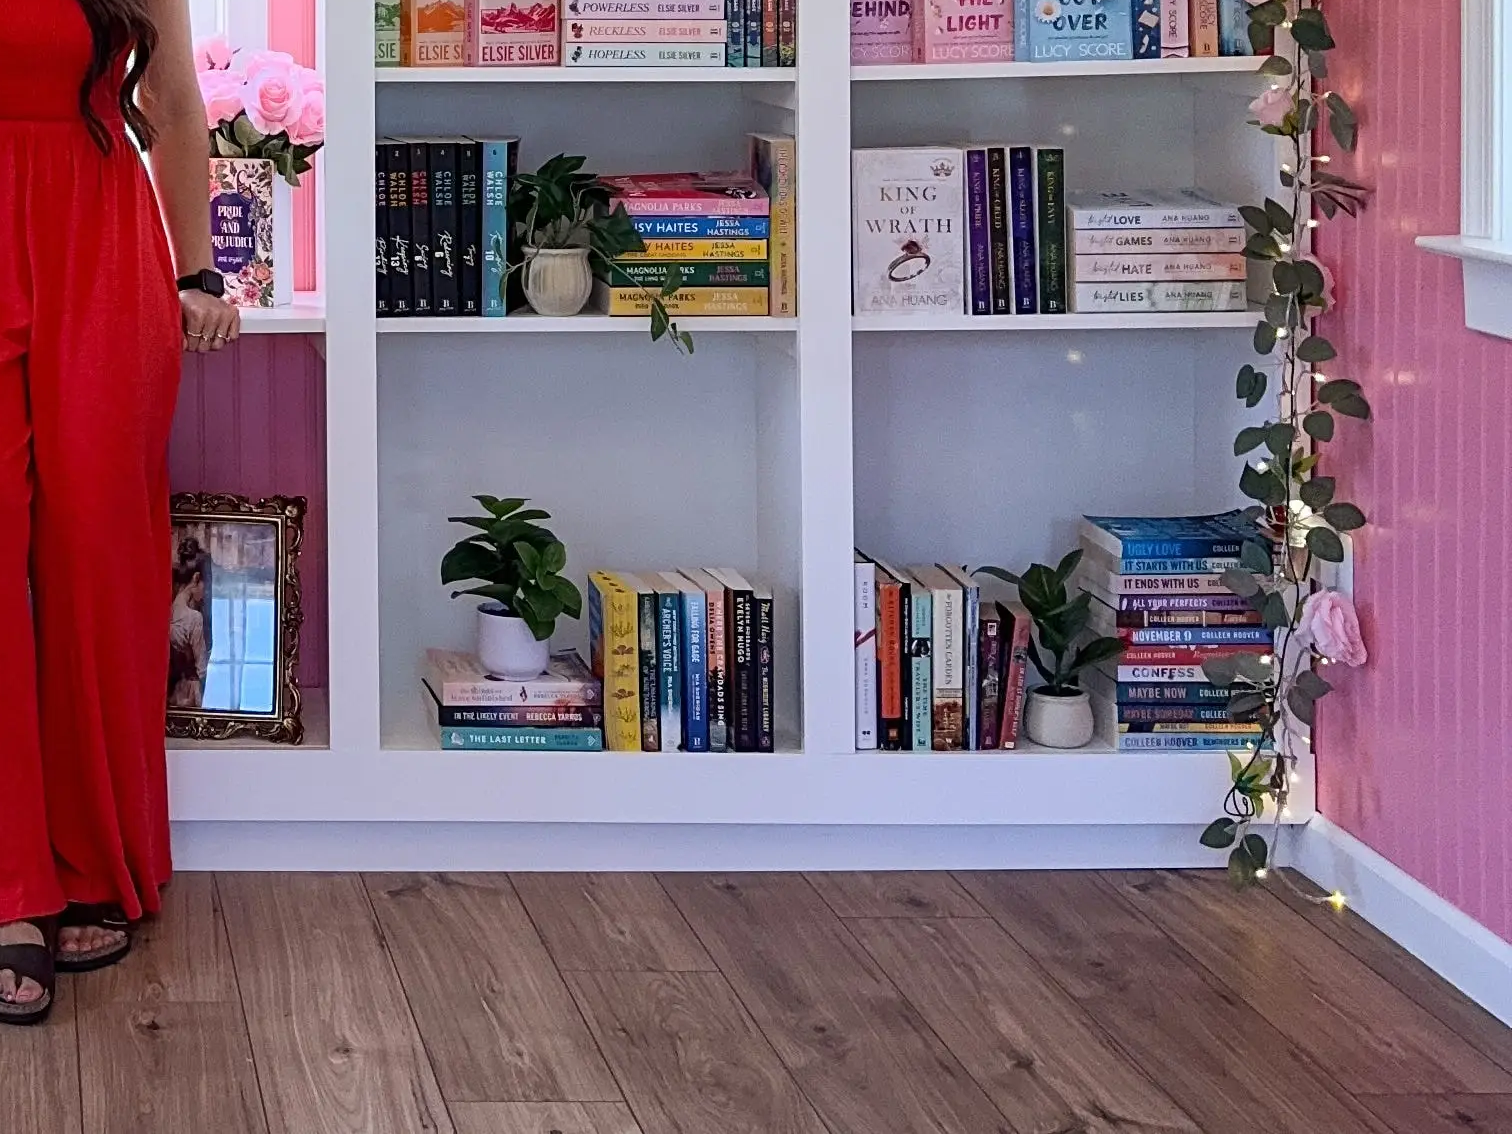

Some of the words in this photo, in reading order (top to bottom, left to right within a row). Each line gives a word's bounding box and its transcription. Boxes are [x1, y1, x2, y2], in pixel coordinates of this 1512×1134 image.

[583, 2, 650, 13] POWERLESS
[657, 3, 675, 13] ELSIE
[677, 3, 701, 13] SILVER
[946, 14, 1004, 33] LIGHT
[1053, 13, 1108, 32] OVER
[418, 43, 450, 62] ELSIE
[481, 45, 515, 62] ELSIE
[517, 43, 555, 62] SILVER
[587, 48, 647, 60] HOPELESS
[657, 50, 676, 60] ELSIE
[677, 50, 702, 60] SILVER
[1034, 44, 1072, 59] LUCY
[1078, 41, 1126, 58] SCORE
[389, 173, 399, 208] WALSH
[397, 172, 407, 208] CHLOE
[435, 171, 444, 207] WALSH
[444, 171, 453, 207] CHLOE
[486, 171, 495, 207] WALSH
[494, 171, 504, 207] CHLOE
[879, 185, 938, 203] KING
[217, 204, 244, 220] PRIDE
[900, 205, 919, 215] OF
[220, 218, 241, 234] AND
[707, 228, 750, 236] HASTINGS
[716, 220, 741, 228] JESSA
[865, 217, 954, 234] WRATH
[210, 234, 254, 250] PREJUDICE
[655, 242, 694, 252] HAITES
[871, 294, 898, 306] ANA
[902, 293, 949, 307] HUANG
[1127, 543, 1153, 557] UGLY
[1155, 542, 1183, 556] LOVE
[1124, 560, 1134, 571] IT
[1135, 560, 1169, 572] STARTS
[1171, 560, 1195, 571] WITH
[1196, 559, 1209, 570] US
[1123, 579, 1133, 590] IT
[1134, 578, 1160, 590] ENDS
[1161, 578, 1186, 589] WITH
[1187, 578, 1200, 589] US
[736, 597, 745, 633] EVELYN
[662, 607, 673, 648] ARCHER'S
[737, 635, 746, 664] HUGO
[662, 649, 673, 673] VOICE
[1132, 667, 1196, 680] CONFESS
[1127, 688, 1161, 699] MAYBE
[1164, 687, 1187, 699] NOW
[469, 734, 487, 743] THE
[489, 734, 512, 744] LAST
[514, 734, 547, 745] LETTER
